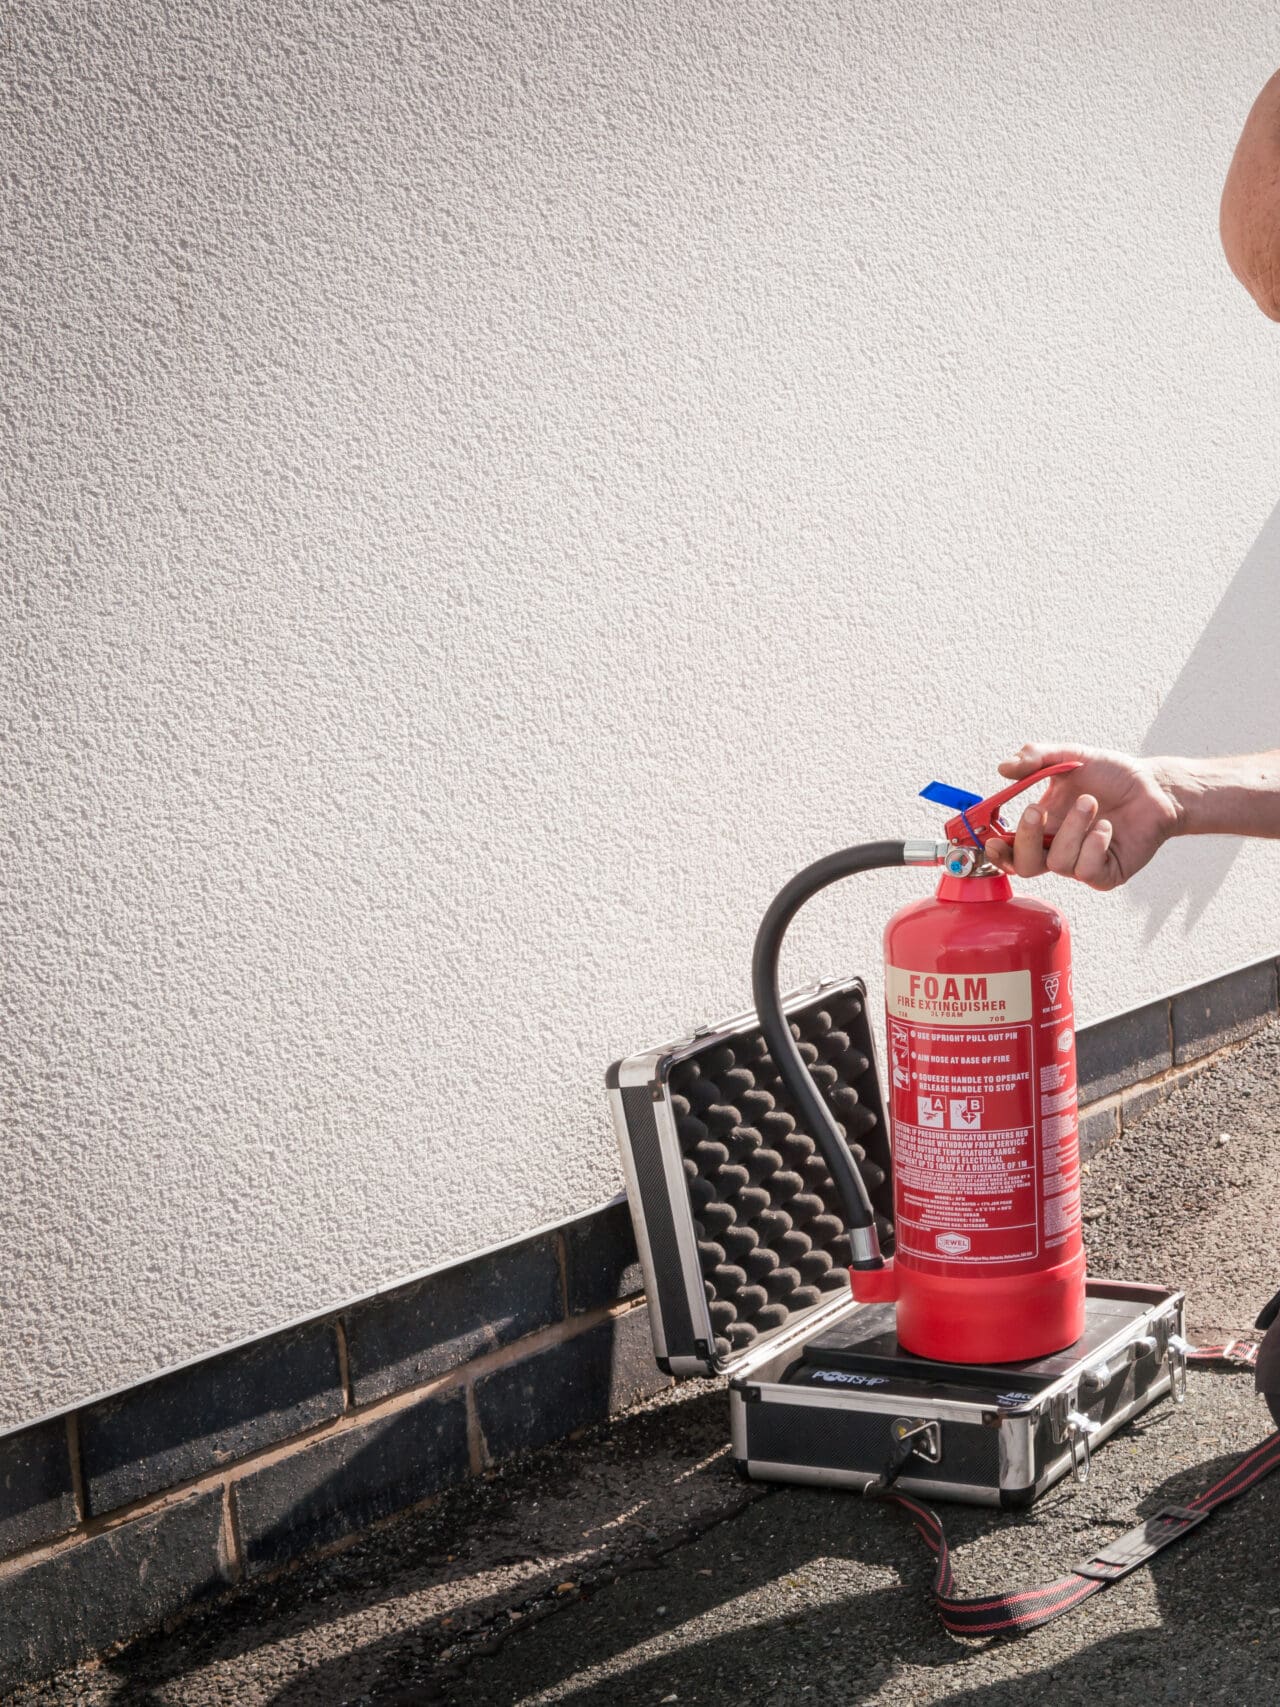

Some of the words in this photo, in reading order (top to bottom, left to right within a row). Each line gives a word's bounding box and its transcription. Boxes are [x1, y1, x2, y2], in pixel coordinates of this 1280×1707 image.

[909, 974, 988, 1001] FOAM
[897, 995, 915, 1008] FIRE
[918, 999, 1006, 1012] EXTINGUISHER
[917, 1032, 930, 1040] USE
[931, 1033, 964, 1042] UPRIGHT
[966, 1033, 987, 1042] PULL
[988, 1033, 1004, 1041] OUT
[1005, 1031, 1018, 1040] PIN
[917, 1054, 930, 1062] AIM
[930, 1055, 949, 1063] HOSE
[950, 1056, 959, 1064] AT
[960, 1056, 980, 1064] BASE
[982, 1055, 992, 1063] OF
[993, 1054, 1010, 1063] FIRE
[919, 1073, 950, 1083] SQUEEZE
[951, 1075, 982, 1084] HANDLE
[984, 1075, 993, 1083] TO
[995, 1072, 1030, 1082] OPERATE
[919, 1082, 950, 1092] RELEASE
[950, 1084, 982, 1093] HANDLE
[984, 1084, 994, 1092] TO
[995, 1083, 1016, 1092] STOP
[934, 1098, 943, 1109] A
[971, 1100, 980, 1110] B
[917, 1129, 949, 1140] PRESSURE
[950, 1133, 987, 1141] INDICATOR
[988, 1131, 1014, 1140] ENTERS
[1015, 1129, 1028, 1138] RED
[937, 1140, 974, 1149] WITHDRAW
[996, 1138, 1027, 1148] SERVICE.
[943, 1148, 992, 1157] TEMPERATURE
[956, 1163, 965, 1171] AT
[972, 1162, 1006, 1171] DISTANCE
[1007, 1161, 1016, 1169] OF
[1018, 1160, 1027, 1168] 1M
[961, 1156, 1003, 1164] ELECTRICAL
